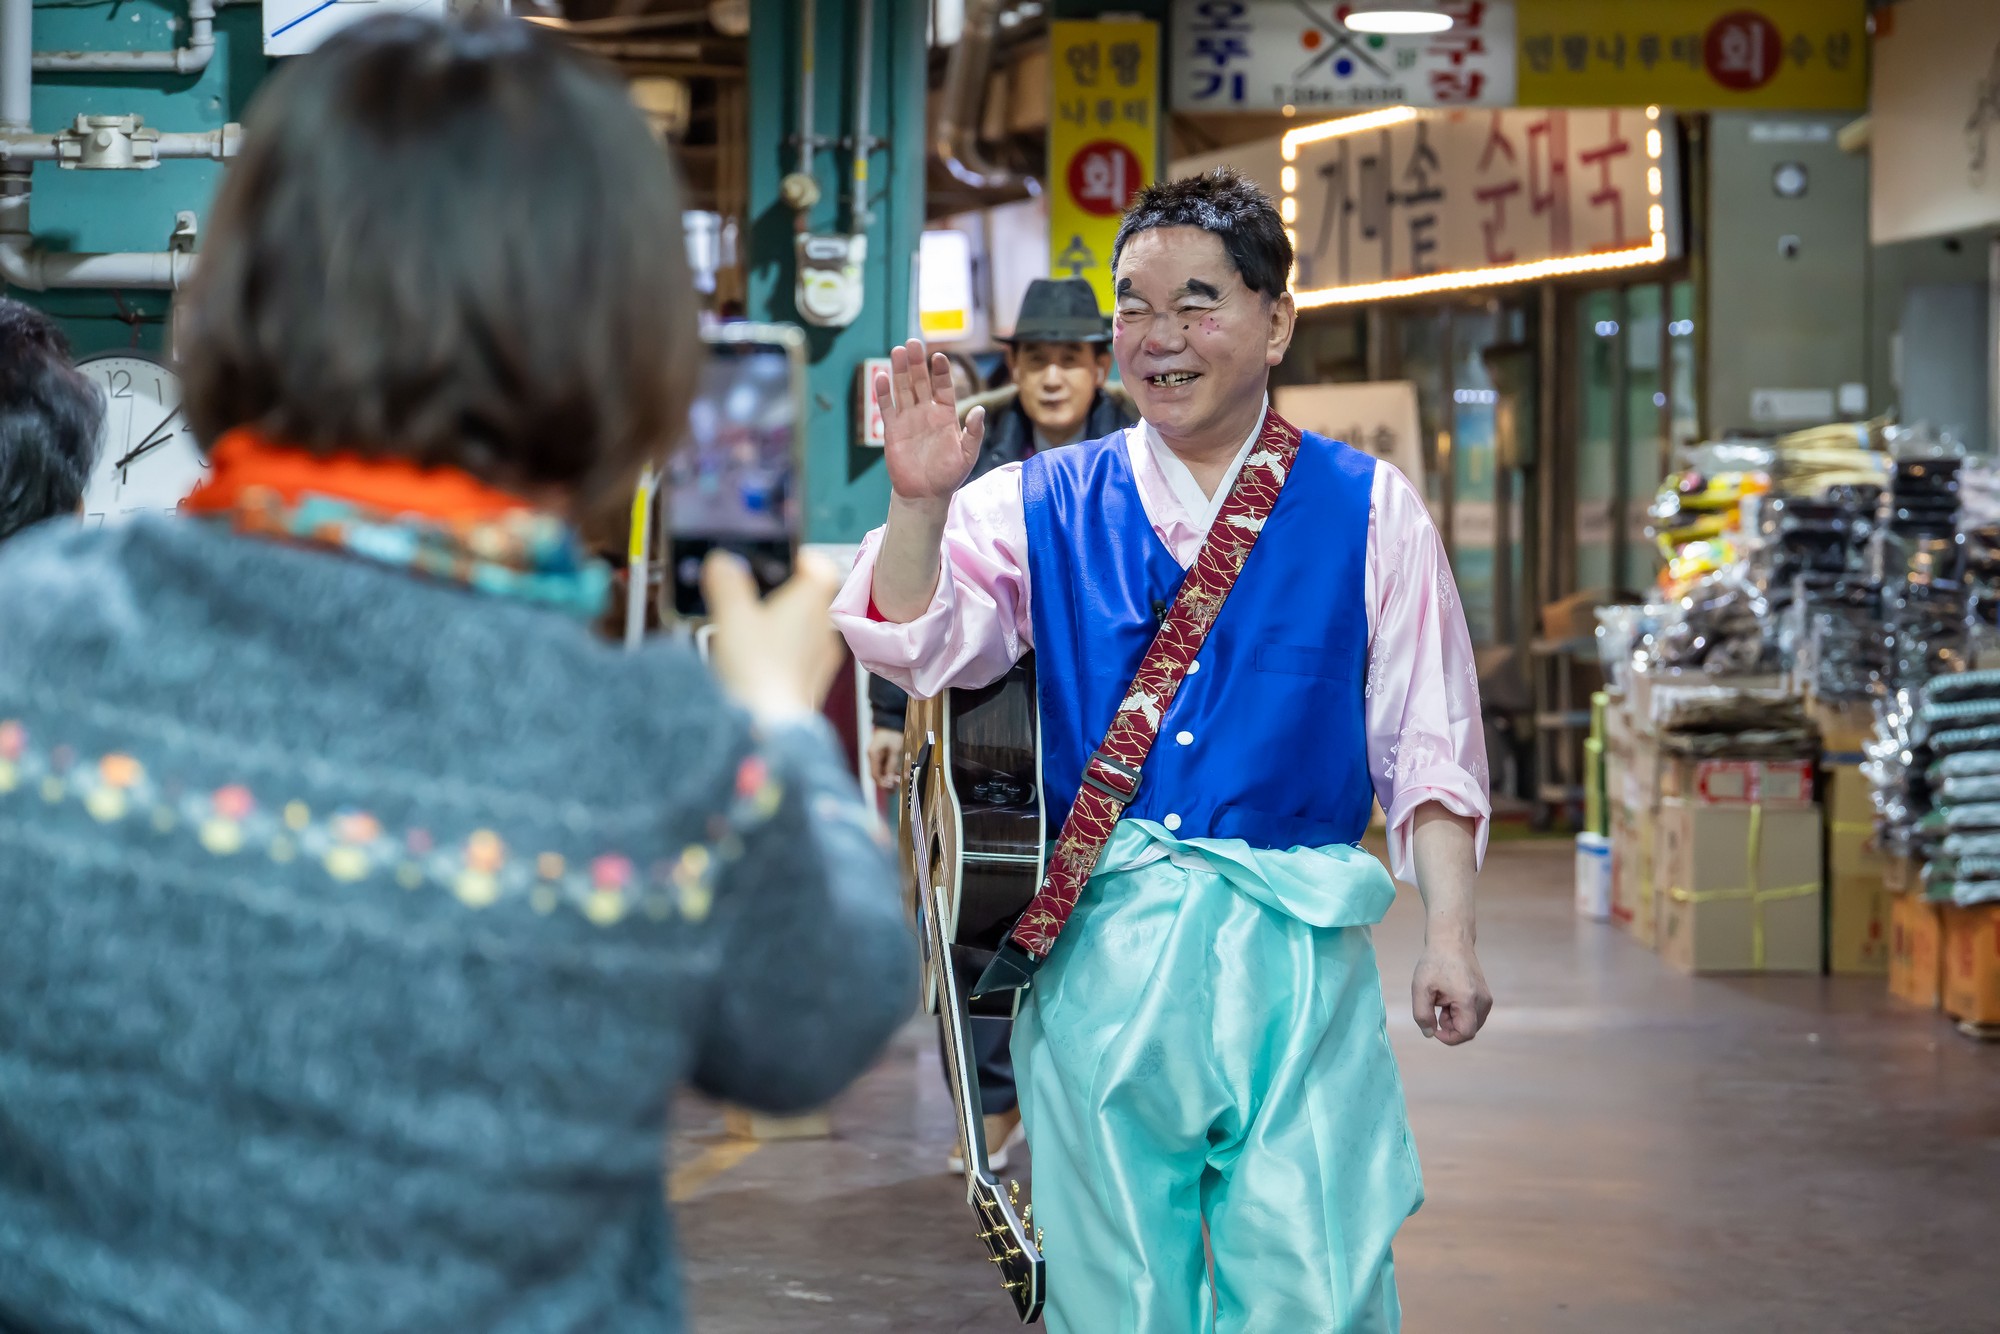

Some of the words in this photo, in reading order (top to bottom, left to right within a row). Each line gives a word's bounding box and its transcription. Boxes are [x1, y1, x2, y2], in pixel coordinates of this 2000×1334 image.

[1720, 21, 1765, 82] 회
[1081, 149, 1126, 209] 회
[106, 369, 134, 399] 12
[155, 378, 163, 406] 1
